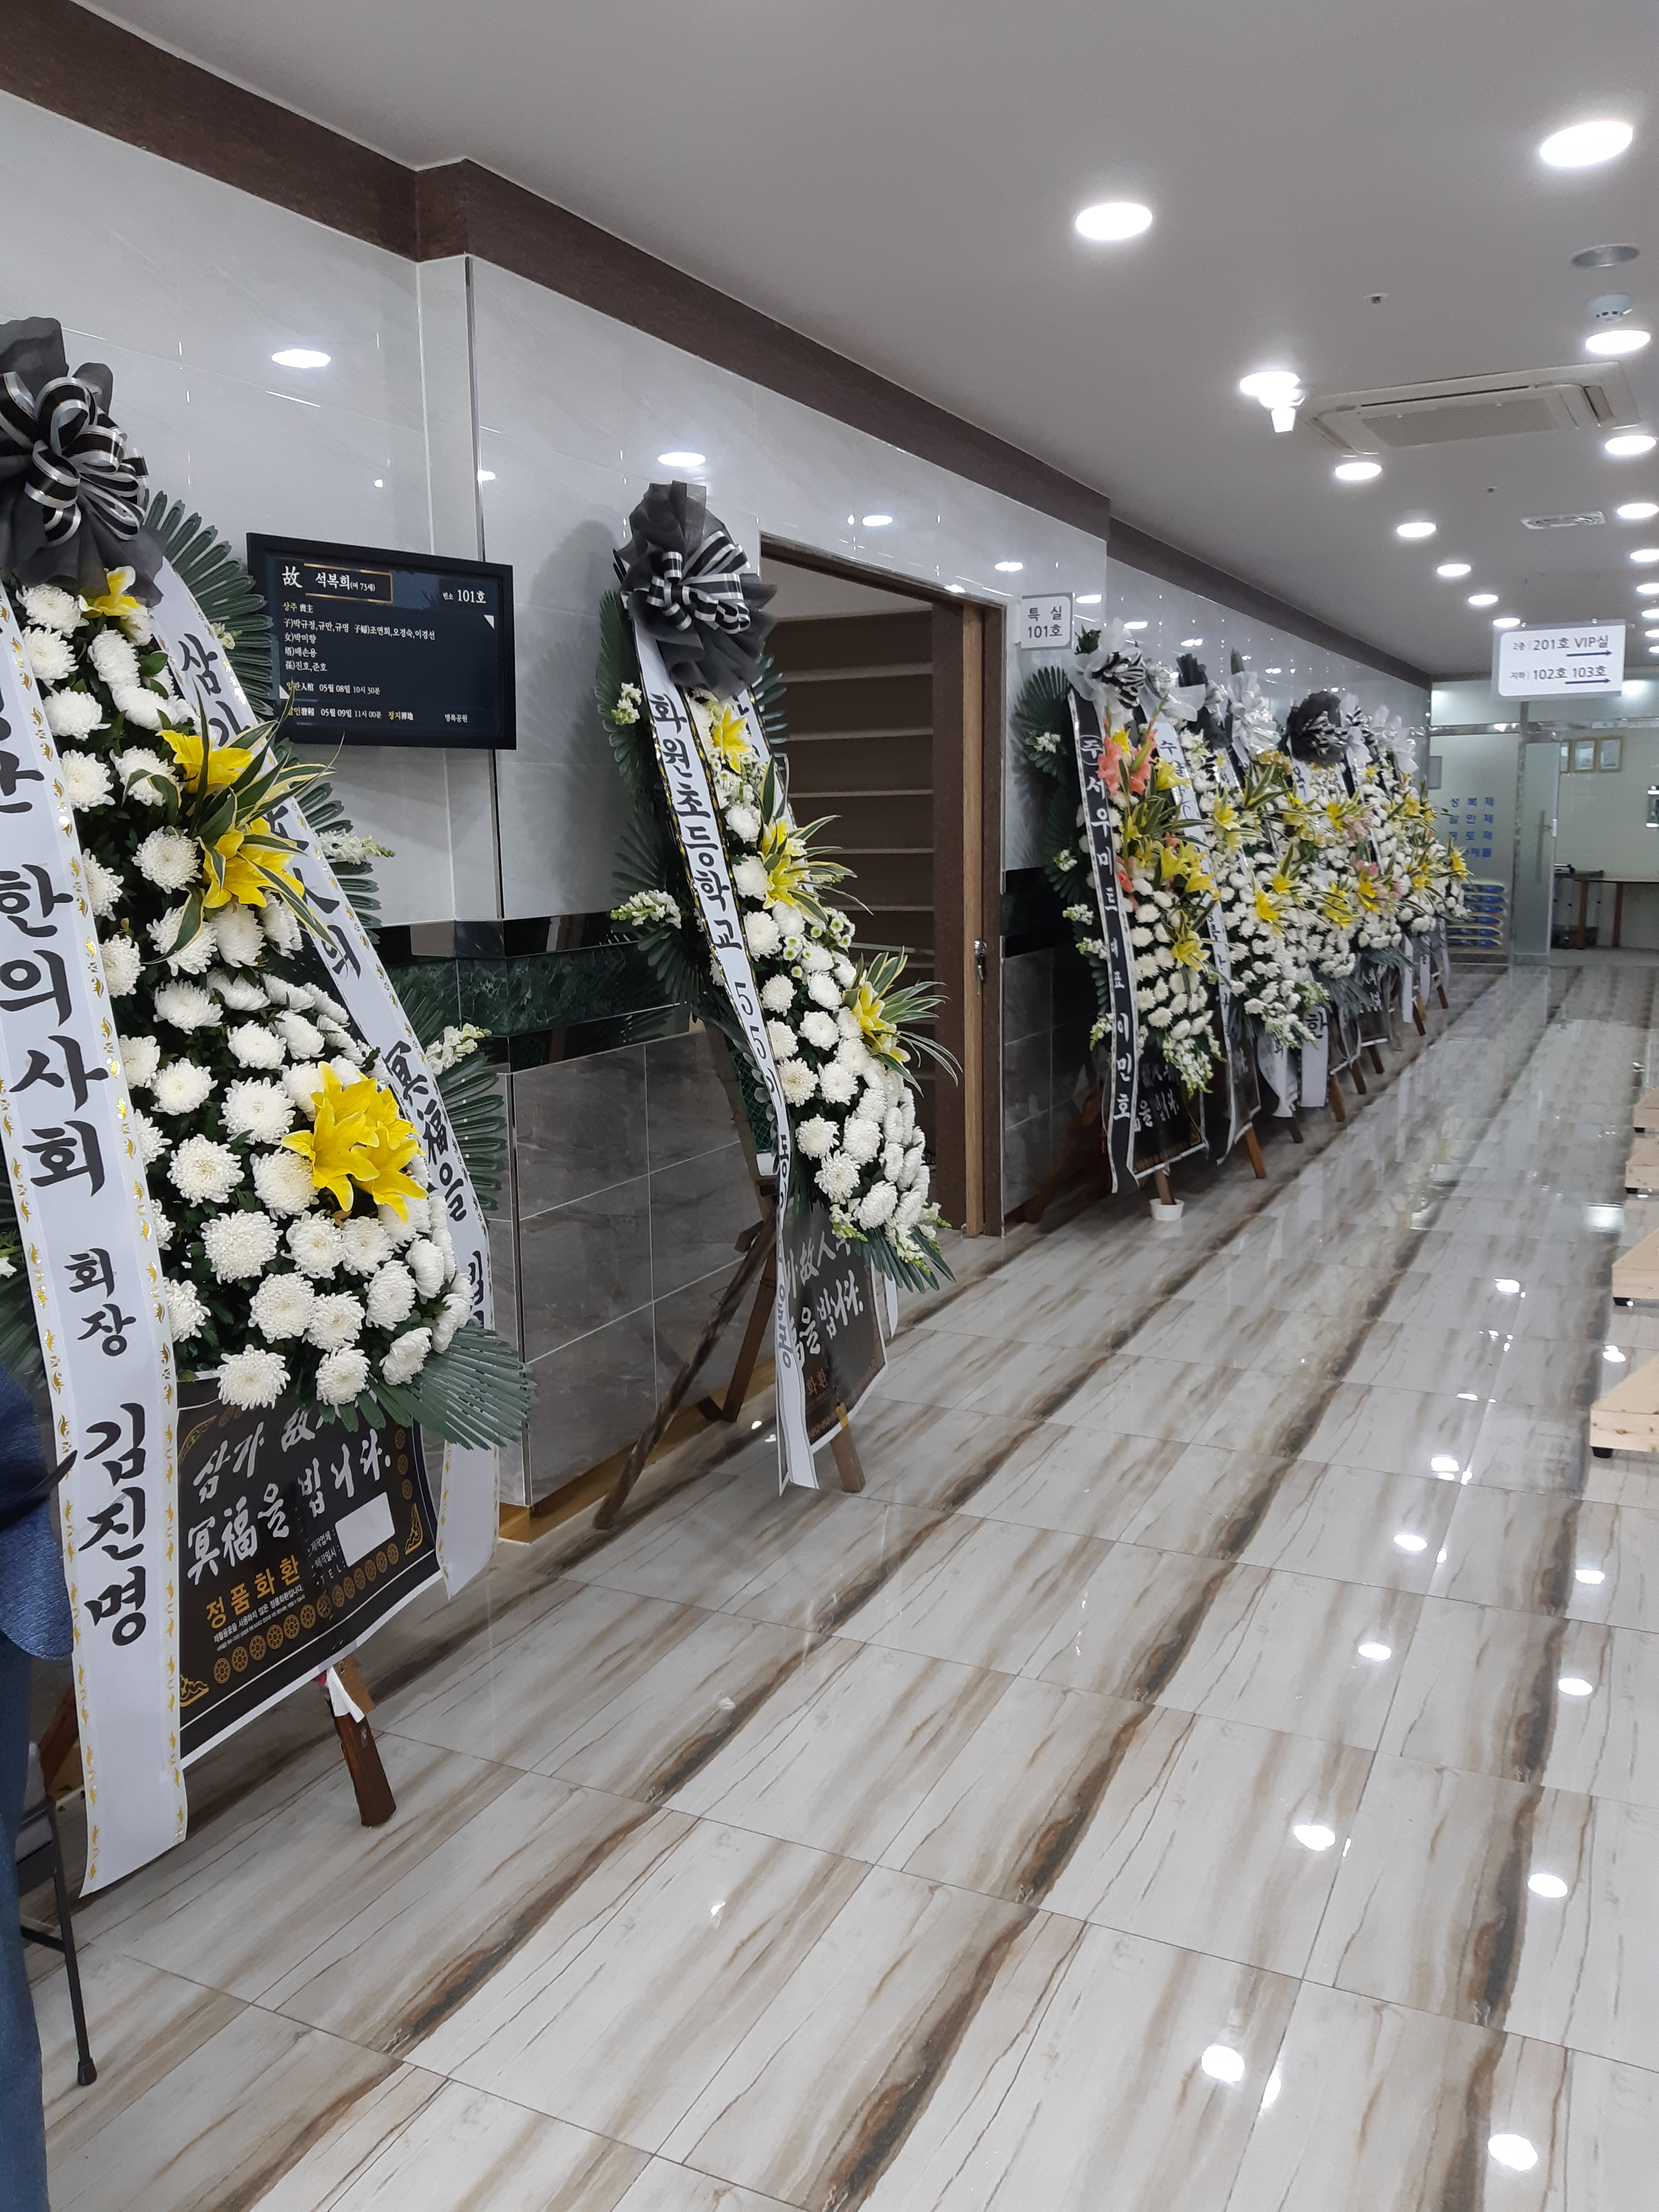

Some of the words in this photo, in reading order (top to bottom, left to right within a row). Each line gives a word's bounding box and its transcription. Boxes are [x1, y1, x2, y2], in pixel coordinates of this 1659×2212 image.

[281, 565, 303, 588] 故
[457, 589, 487, 604] 101호
[282, 601, 298, 612] 상주
[1028, 624, 1062, 639] 101호
[1533, 637, 1570, 651] 201호
[1574, 635, 1609, 649] VIP실
[1533, 667, 1568, 680] 102호
[1572, 665, 1607, 678] 103호
[319, 683, 334, 693] 05월
[336, 684, 350, 694] 08일
[353, 685, 366, 695] 10시
[367, 686, 381, 695] 30분
[321, 708, 336, 718] 05월
[337, 709, 352, 718] 09일
[354, 710, 367, 719] 11시
[369, 711, 382, 719] 00분
[650, 693, 742, 950] 화원초등학교
[0, 864, 108, 1196] 한의사회
[1113, 1012, 1133, 1121] 이민호
[64, 1247, 136, 1356] 회장
[79, 1403, 147, 1646] 김진명
